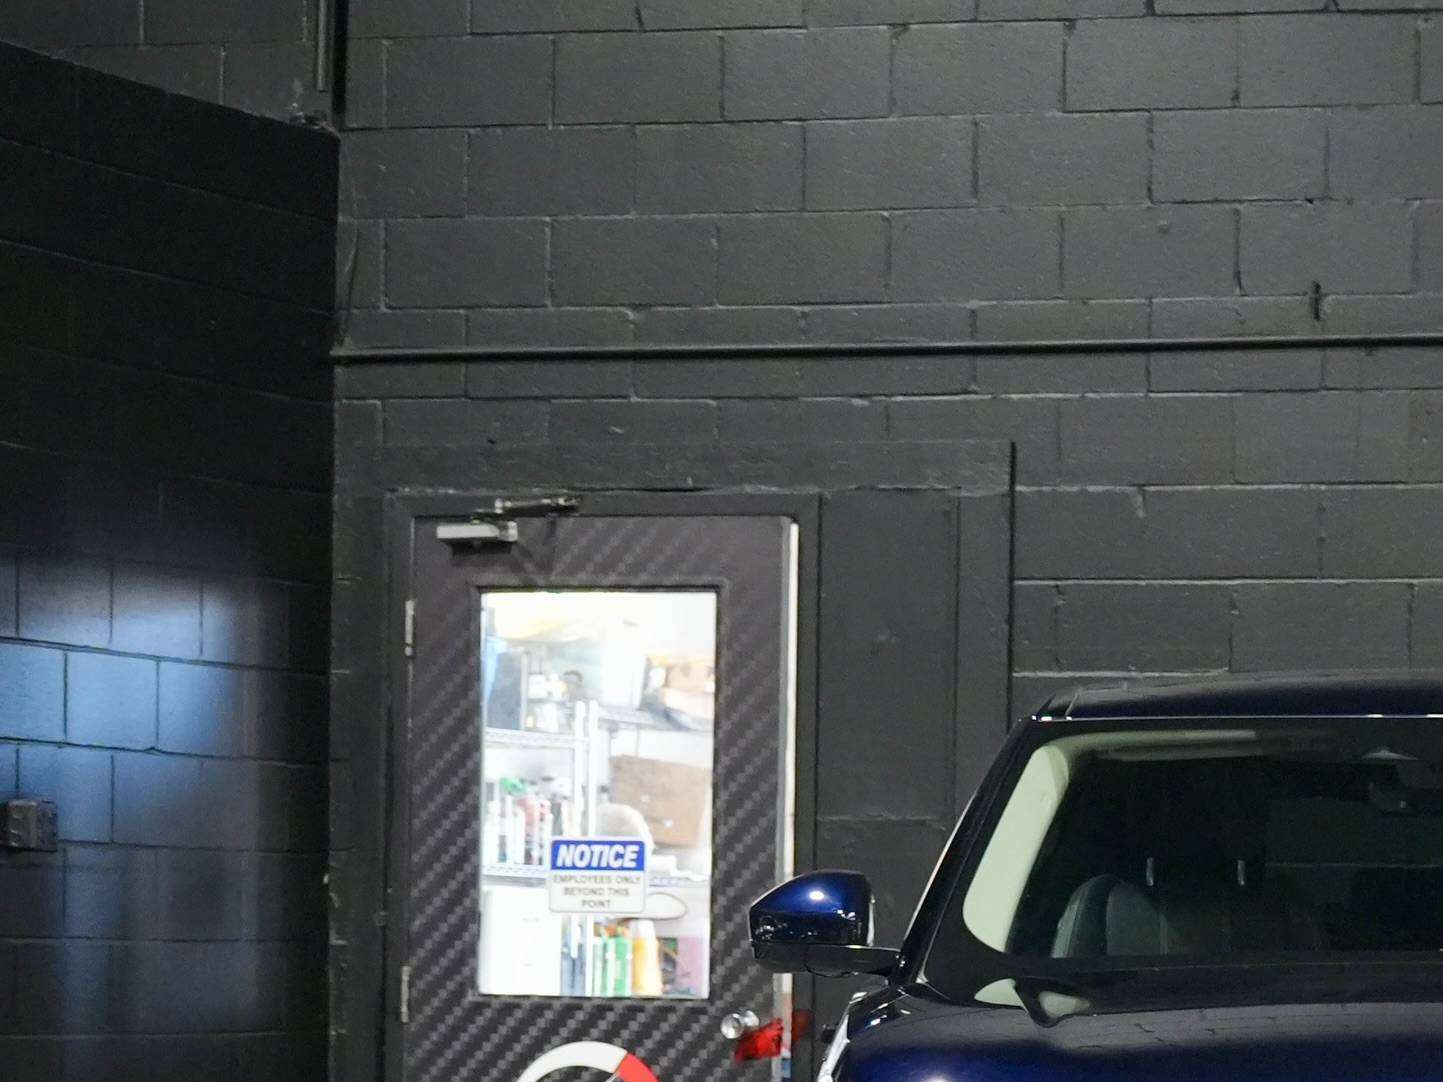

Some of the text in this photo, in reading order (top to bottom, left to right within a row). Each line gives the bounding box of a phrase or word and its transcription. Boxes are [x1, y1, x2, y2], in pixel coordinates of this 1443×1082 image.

[556, 844, 640, 868] NOTICE
[553, 874, 641, 885] EMPLOYEES ONLY
[563, 887, 629, 896] BEYOND THIS
[581, 899, 611, 908] POINT
